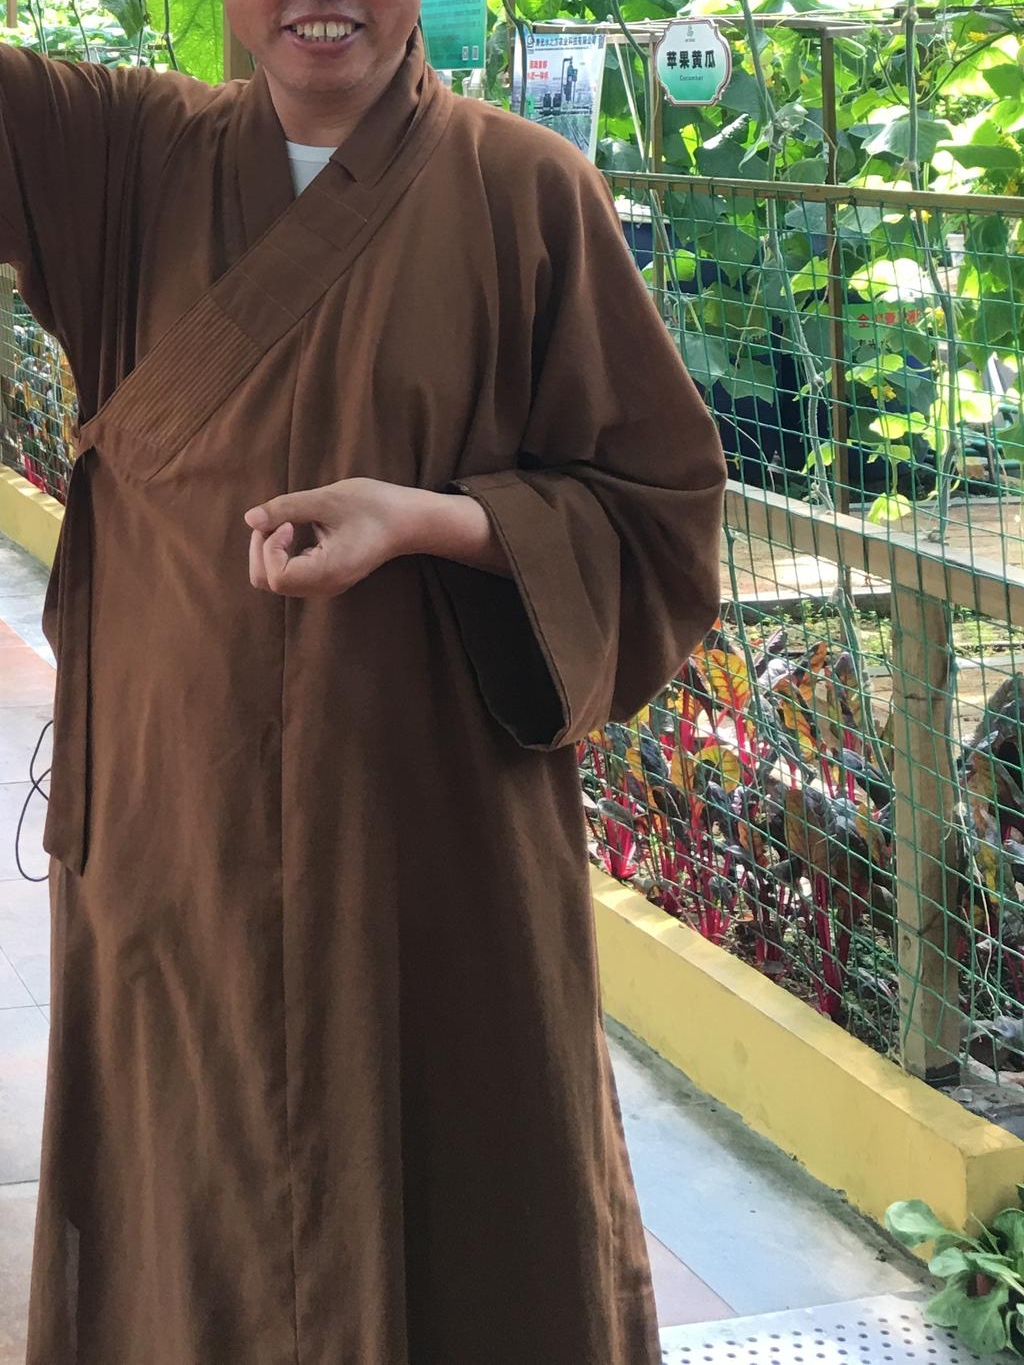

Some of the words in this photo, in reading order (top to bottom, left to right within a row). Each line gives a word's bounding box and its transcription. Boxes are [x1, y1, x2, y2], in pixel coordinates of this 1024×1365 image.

[666, 49, 716, 70] 苹果黄瓜
[679, 74, 704, 82] Cucumber
